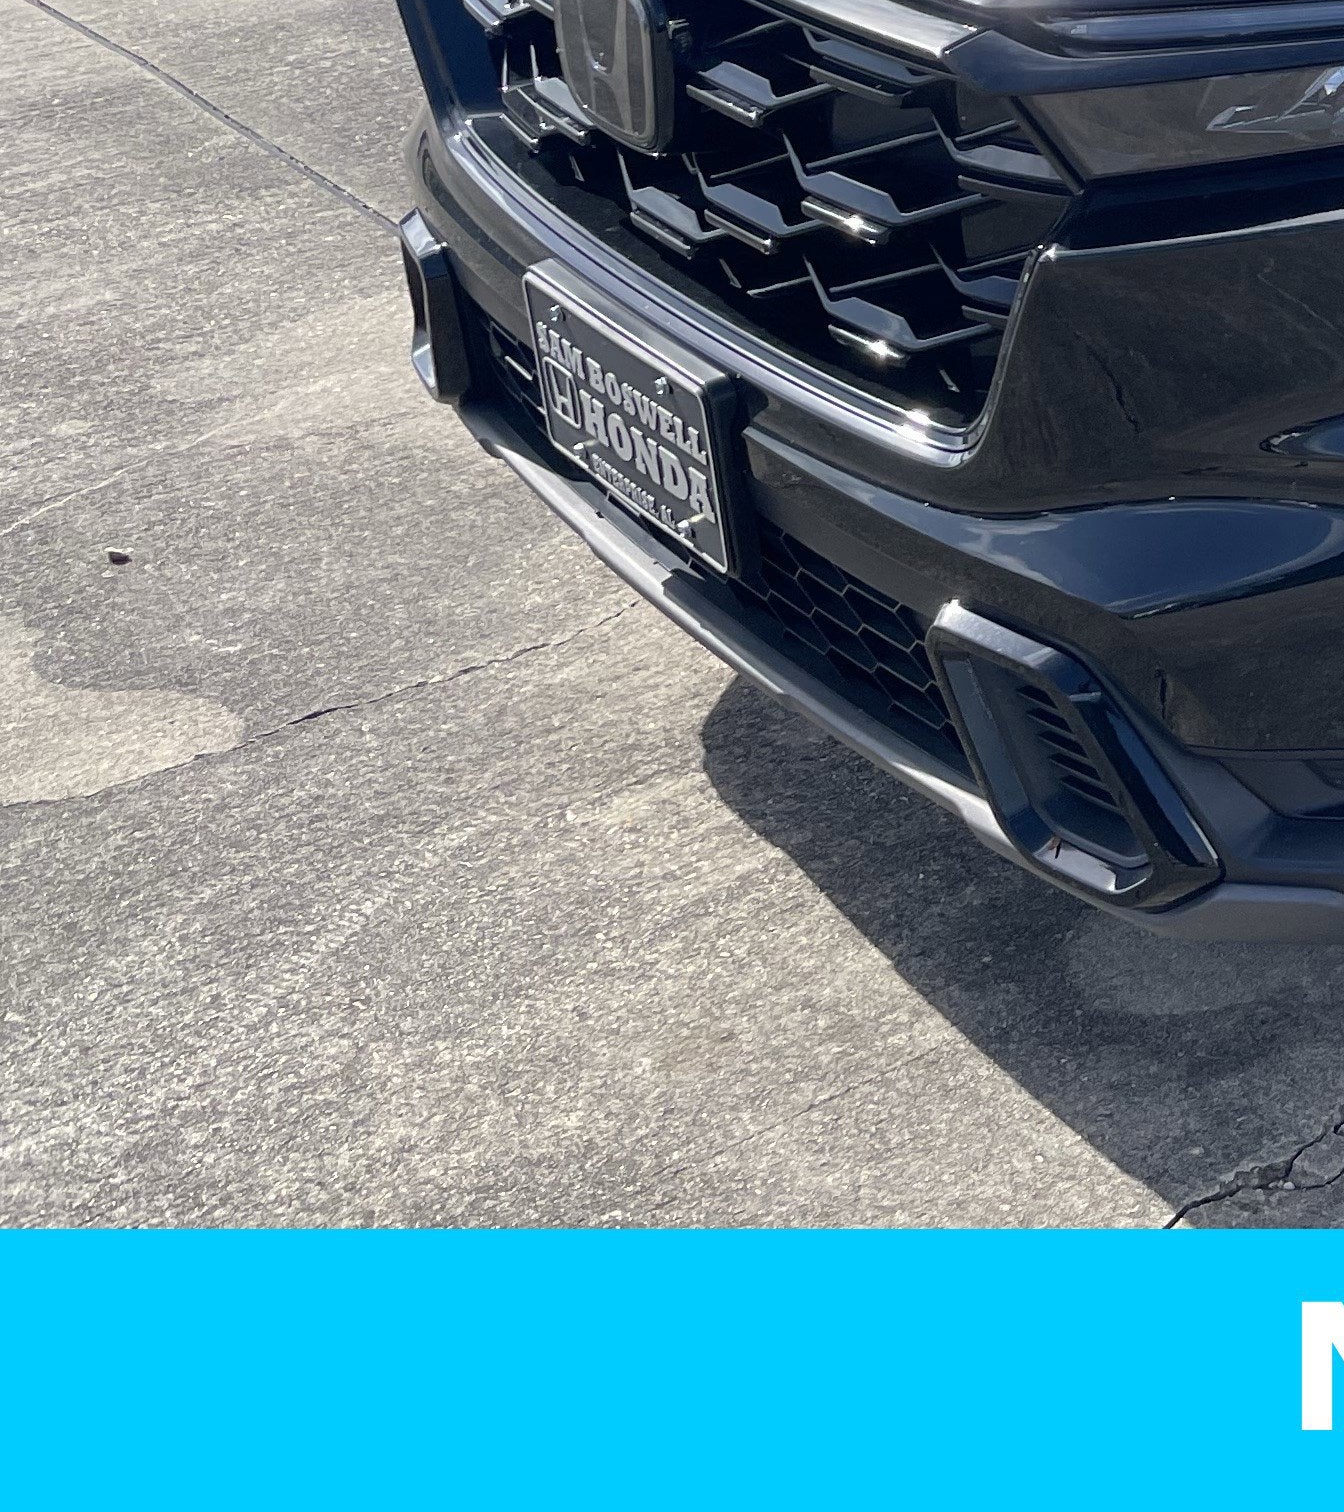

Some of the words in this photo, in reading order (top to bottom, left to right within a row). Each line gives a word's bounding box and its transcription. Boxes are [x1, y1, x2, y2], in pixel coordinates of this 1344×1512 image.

[535, 321, 586, 381] SAM
[586, 357, 708, 466] BOSWELL
[579, 389, 716, 524] HONDA
